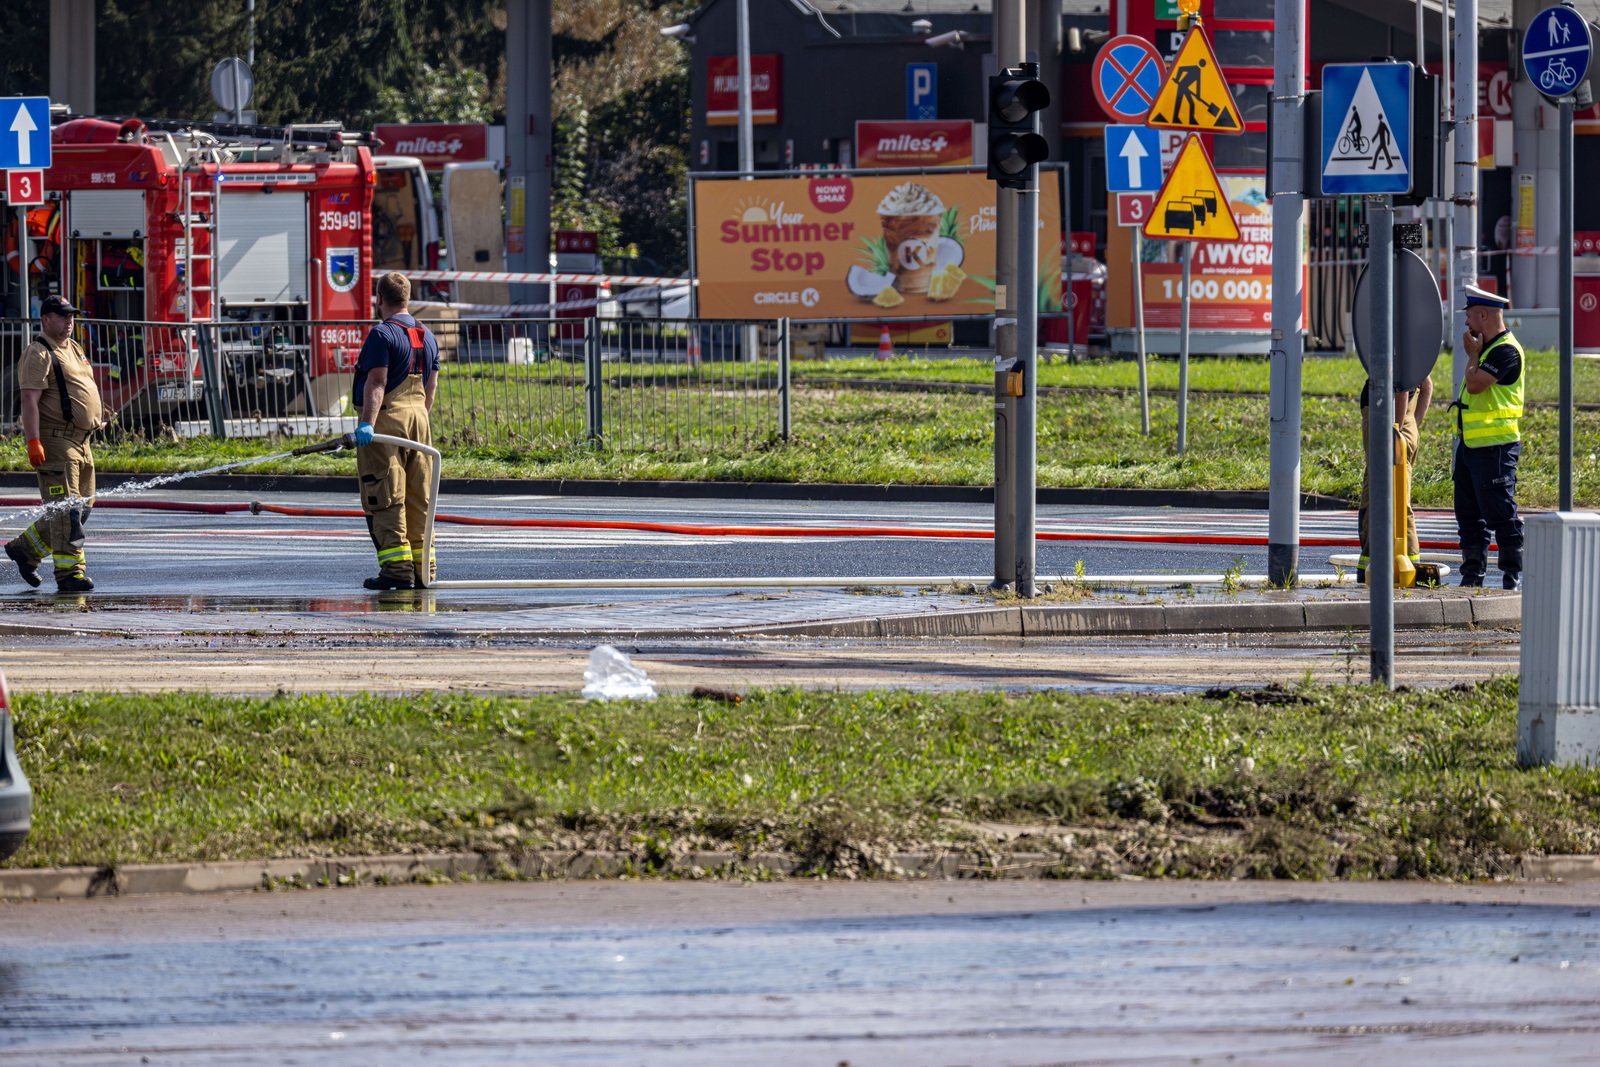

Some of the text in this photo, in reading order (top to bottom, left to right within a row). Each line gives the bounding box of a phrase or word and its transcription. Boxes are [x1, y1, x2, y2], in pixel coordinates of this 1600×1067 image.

[914, 69, 931, 106] P
[877, 134, 948, 152] miles+
[20, 176, 32, 198] 3
[815, 185, 847, 194] NOWY
[817, 194, 846, 203] SMAK
[770, 201, 804, 229] Your
[979, 206, 996, 215] ICE
[1130, 199, 1143, 219] 3
[319, 211, 361, 230] 359 91
[720, 219, 855, 243] Summer
[751, 247, 825, 276] Stop
[753, 288, 819, 306] CIRCLE K
[1162, 279, 1173, 298] 1
[1223, 279, 1263, 300] 000
